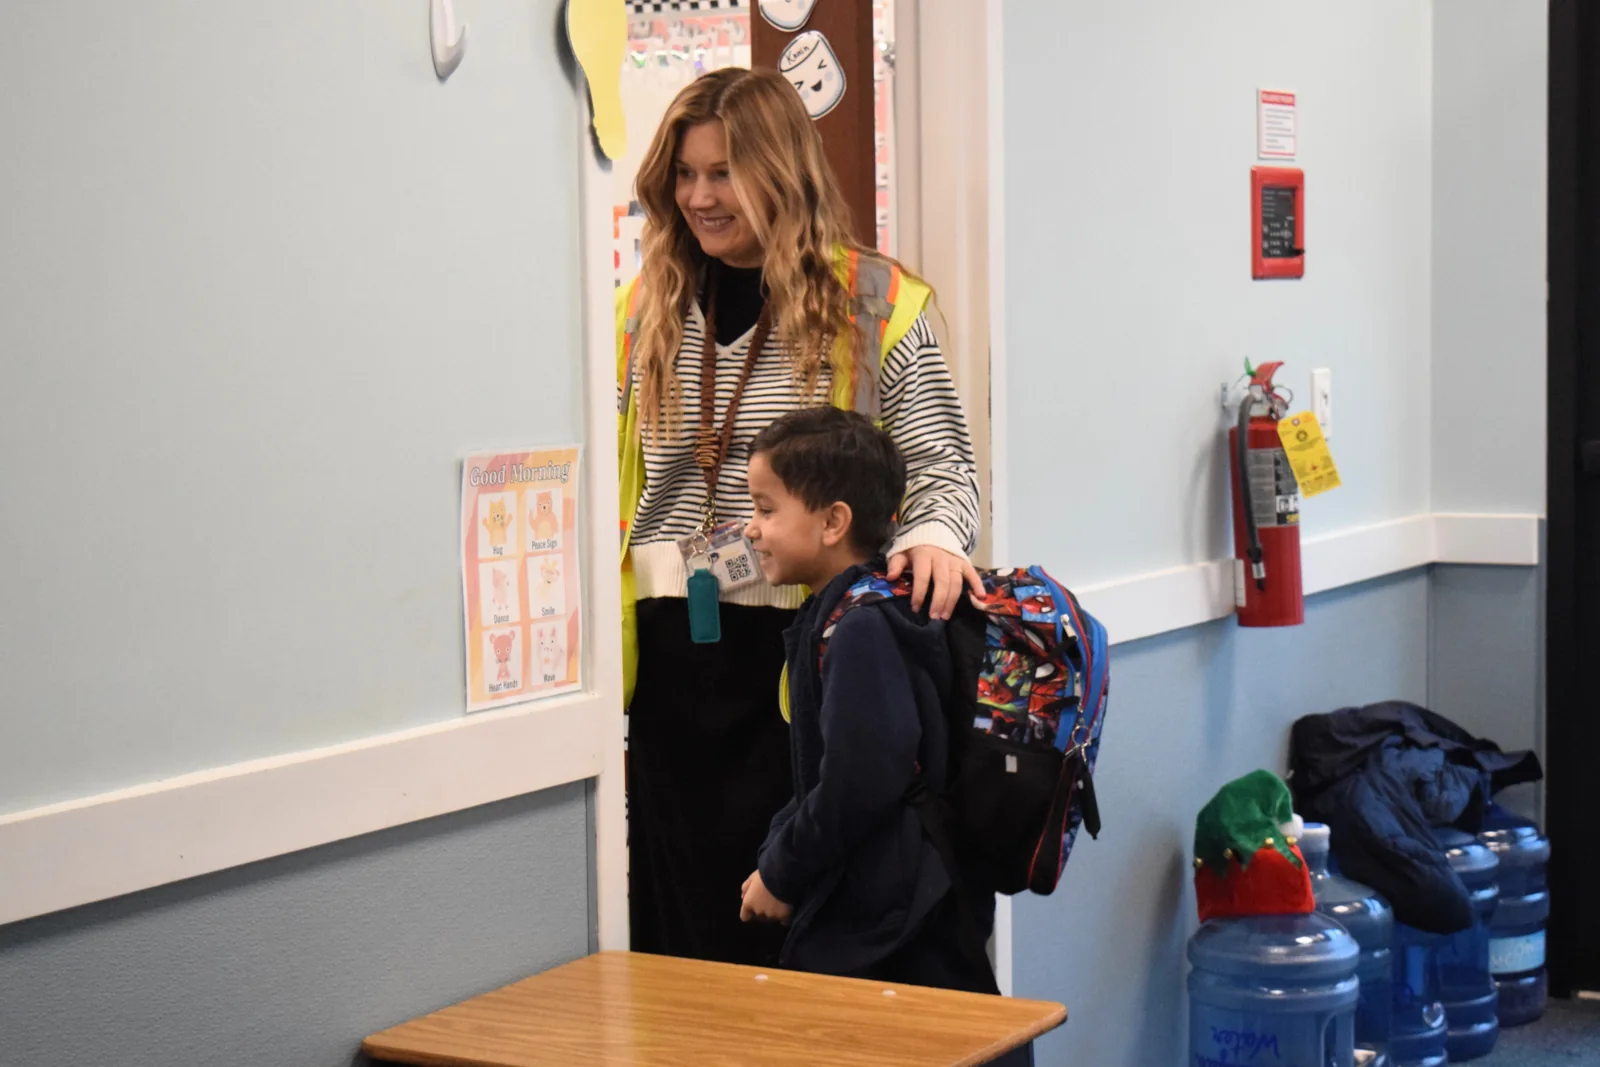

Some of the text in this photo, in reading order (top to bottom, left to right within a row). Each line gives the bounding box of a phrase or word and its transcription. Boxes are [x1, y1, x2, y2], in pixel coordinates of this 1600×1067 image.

[470, 460, 571, 487] Good Morning
[531, 539, 558, 550] Peace Sign
[492, 545, 504, 556] Hug
[541, 606, 556, 617] Smile
[493, 613, 510, 624] Dance
[543, 673, 556, 683] Wave
[488, 680, 519, 693] Heart Hands
[1210, 1026, 1281, 1060] Water
